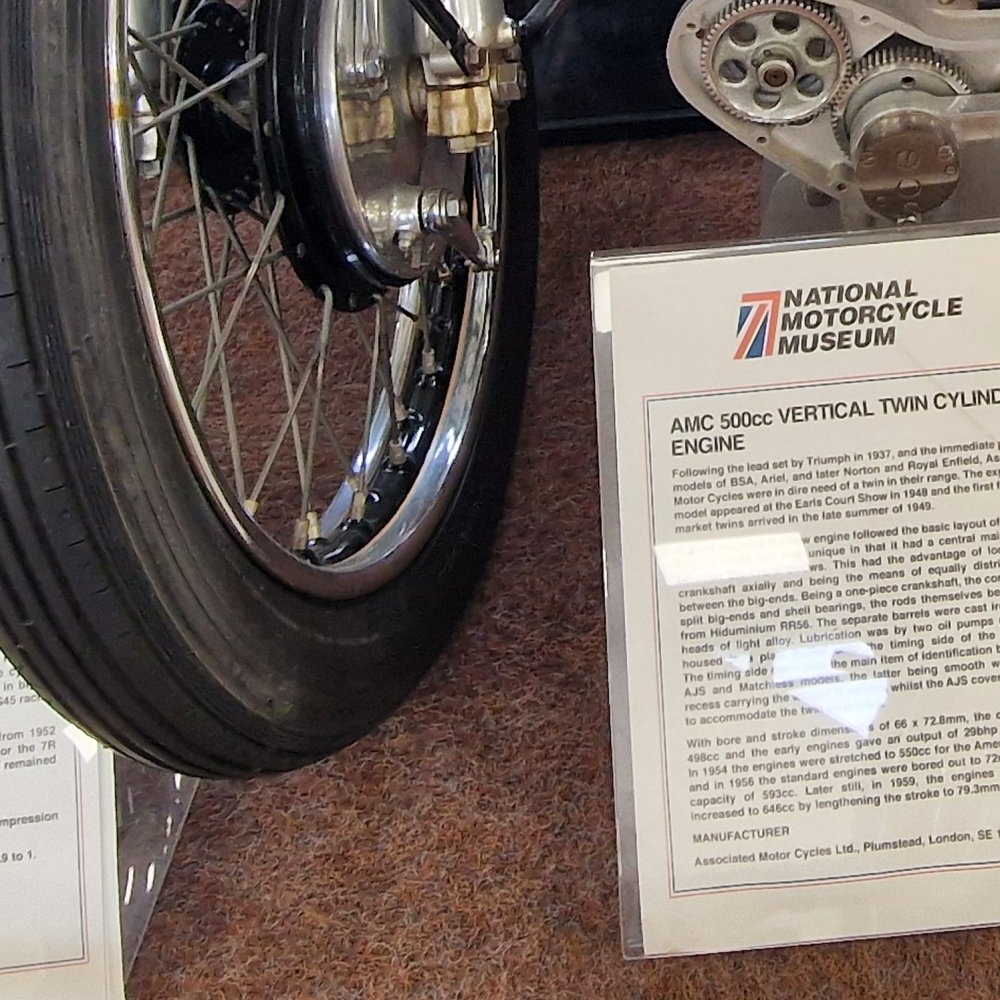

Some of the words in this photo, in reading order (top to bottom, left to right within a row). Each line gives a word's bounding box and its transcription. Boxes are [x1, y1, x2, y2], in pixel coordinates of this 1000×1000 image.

[784, 279, 918, 308] NATIONAL
[781, 297, 963, 332] MOTORCYCLE
[778, 327, 896, 355] MUSEUM
[670, 414, 714, 434] AMC
[720, 411, 773, 430] 500cc
[777, 400, 875, 424] VERTICAL
[878, 394, 928, 414] TWIN
[671, 433, 746, 456] ENGINE
[671, 466, 725, 478] Following
[726, 463, 744, 474] the
[746, 460, 769, 472] lead
[771, 459, 788, 470] set
[790, 458, 804, 469] by
[806, 453, 851, 466] Triumph
[853, 452, 864, 462] in
[867, 449, 895, 460] 1937,
[897, 447, 918, 458] and
[919, 446, 938, 456] the
[939, 440, 995, 454] immediate
[672, 479, 712, 492] models
[715, 478, 726, 488] of
[730, 475, 757, 487] BSA,
[760, 472, 789, 484] Ariel,
[792, 470, 813, 481] and
[815, 469, 840, 479] later
[843, 466, 880, 476] Norton
[884, 461, 904, 473] and
[907, 458, 938, 472] Royal
[941, 455, 982, 468] Enfield,
[673, 495, 705, 506] Motor
[706, 491, 744, 505] Cycles
[745, 489, 773, 499] were
[774, 487, 785, 497] in
[786, 485, 809, 496] dire
[810, 481, 837, 494] need
[839, 480, 850, 491] of
[852, 481, 860, 490] a
[861, 478, 885, 489] twin
[886, 477, 897, 486] in
[899, 473, 924, 486] their
[926, 472, 960, 484] range.
[962, 469, 983, 479] The
[673, 507, 707, 520] model
[709, 503, 760, 519] appeared
[762, 501, 773, 512] at
[775, 500, 792, 511] the
[794, 497, 822, 509] Earls
[824, 494, 855, 506] Court
[857, 492, 888, 503] Show
[889, 490, 901, 500] in
[930, 485, 951, 496] and
[952, 484, 970, 494] the
[972, 481, 994, 492] first
[674, 521, 712, 533] market
[715, 519, 744, 530] twins
[747, 513, 785, 527] arrived
[788, 513, 799, 523] in
[801, 512, 819, 522] the
[821, 510, 842, 520] late
[845, 506, 889, 518] summer
[891, 503, 903, 514] of
[906, 501, 934, 512] 1949.
[18, 744, 35, 754] the
[41, 740, 56, 750] 7R
[30, 726, 56, 738] 1952
[4, 754, 56, 769] remained
[688, 767, 699, 778] In
[702, 764, 728, 776] 1954
[730, 763, 749, 774] the
[752, 760, 796, 773] engines
[798, 757, 826, 767] were
[829, 750, 881, 764] stretched
[884, 749, 896, 759] to
[898, 746, 931, 758] 550cc
[934, 744, 950, 754] for
[953, 742, 971, 753] the
[690, 806, 745, 821] increased
[747, 806, 760, 816] to
[762, 802, 795, 814] 646cc
[798, 801, 812, 813] by
[814, 794, 881, 810] lengthening
[883, 793, 902, 803] the
[904, 788, 940, 801] stroke
[942, 787, 954, 797] to
[692, 825, 790, 843] MANUFACTURER
[694, 852, 756, 867] Associated
[758, 851, 791, 861] Motor
[794, 846, 832, 860] Cycles
[863, 835, 925, 852] Plumstead,
[928, 831, 974, 845] London,
[977, 828, 993, 840] SE
[12, 852, 24, 862] to
[27, 850, 36, 860] 1.
